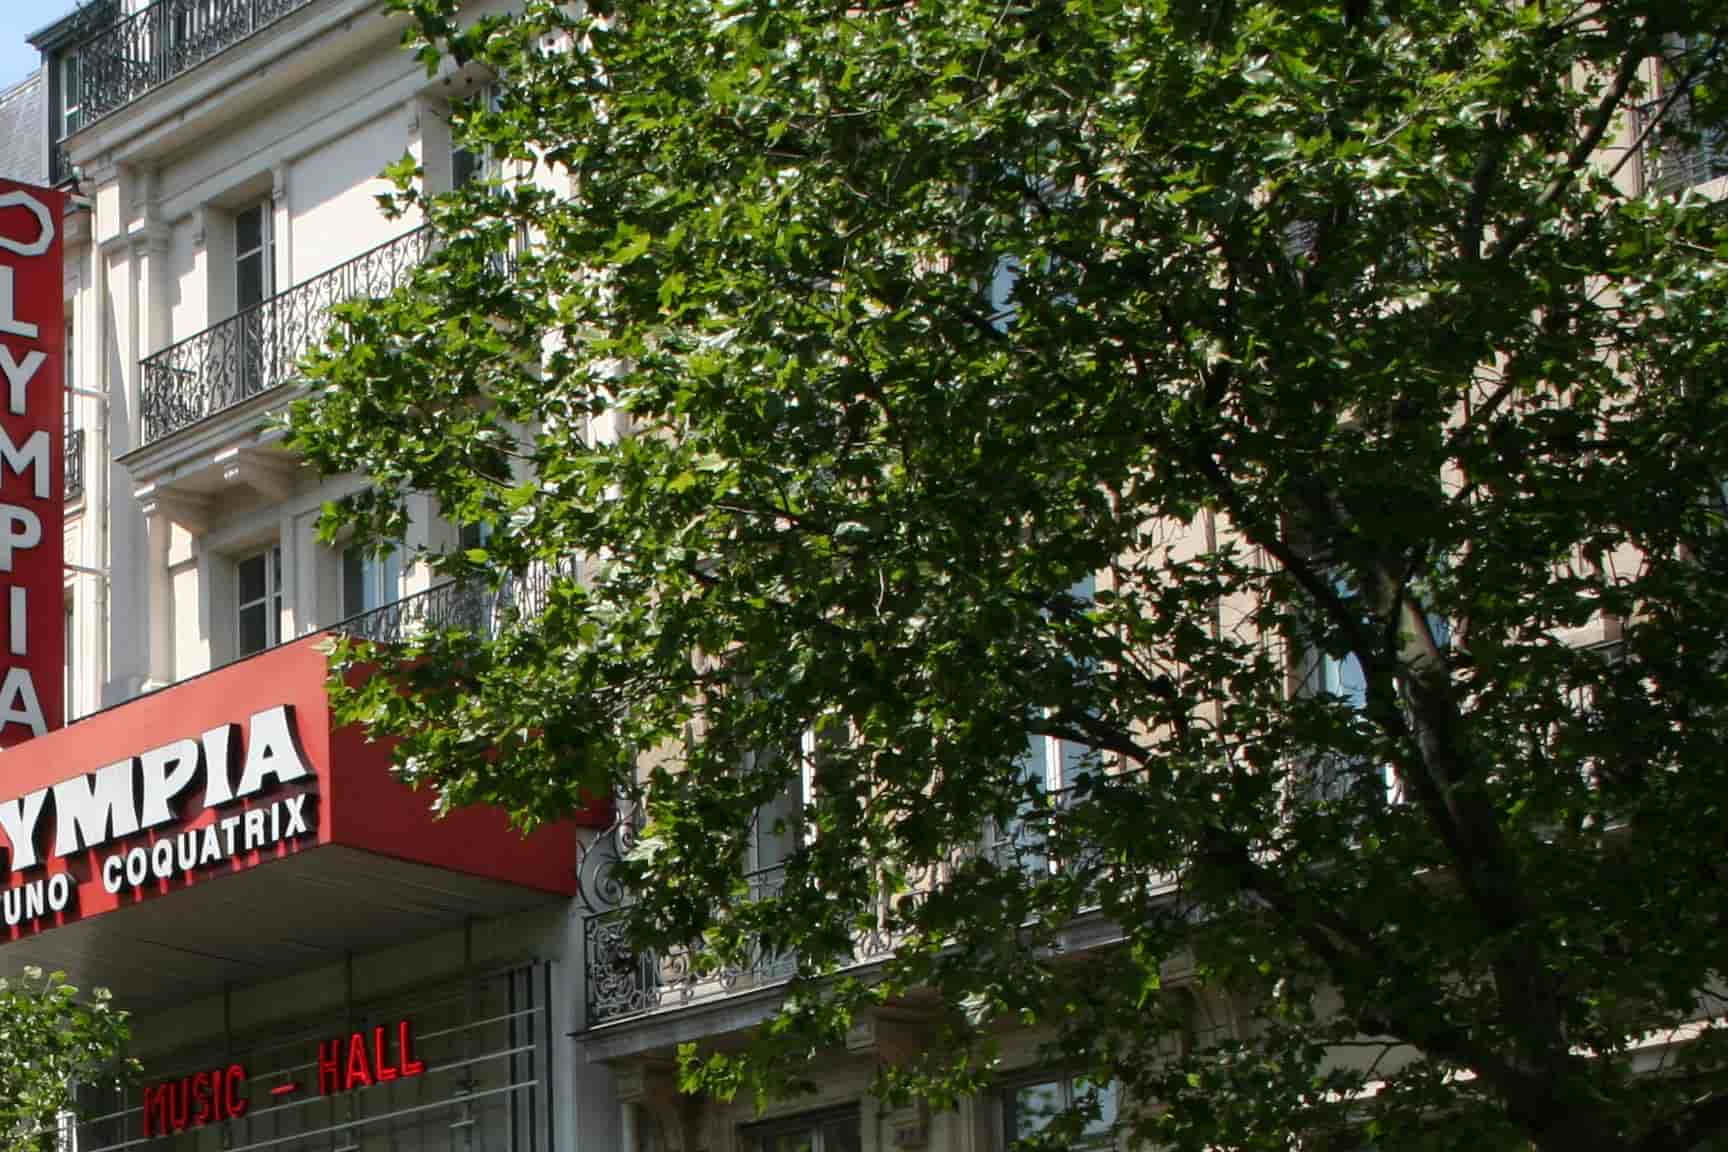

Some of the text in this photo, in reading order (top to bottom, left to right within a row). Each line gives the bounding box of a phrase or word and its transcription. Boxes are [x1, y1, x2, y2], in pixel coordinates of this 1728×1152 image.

[103, 793, 308, 894] COQUATRIX
[142, 1063, 247, 1138] MUSIC
[316, 1020, 426, 1096] HALL
